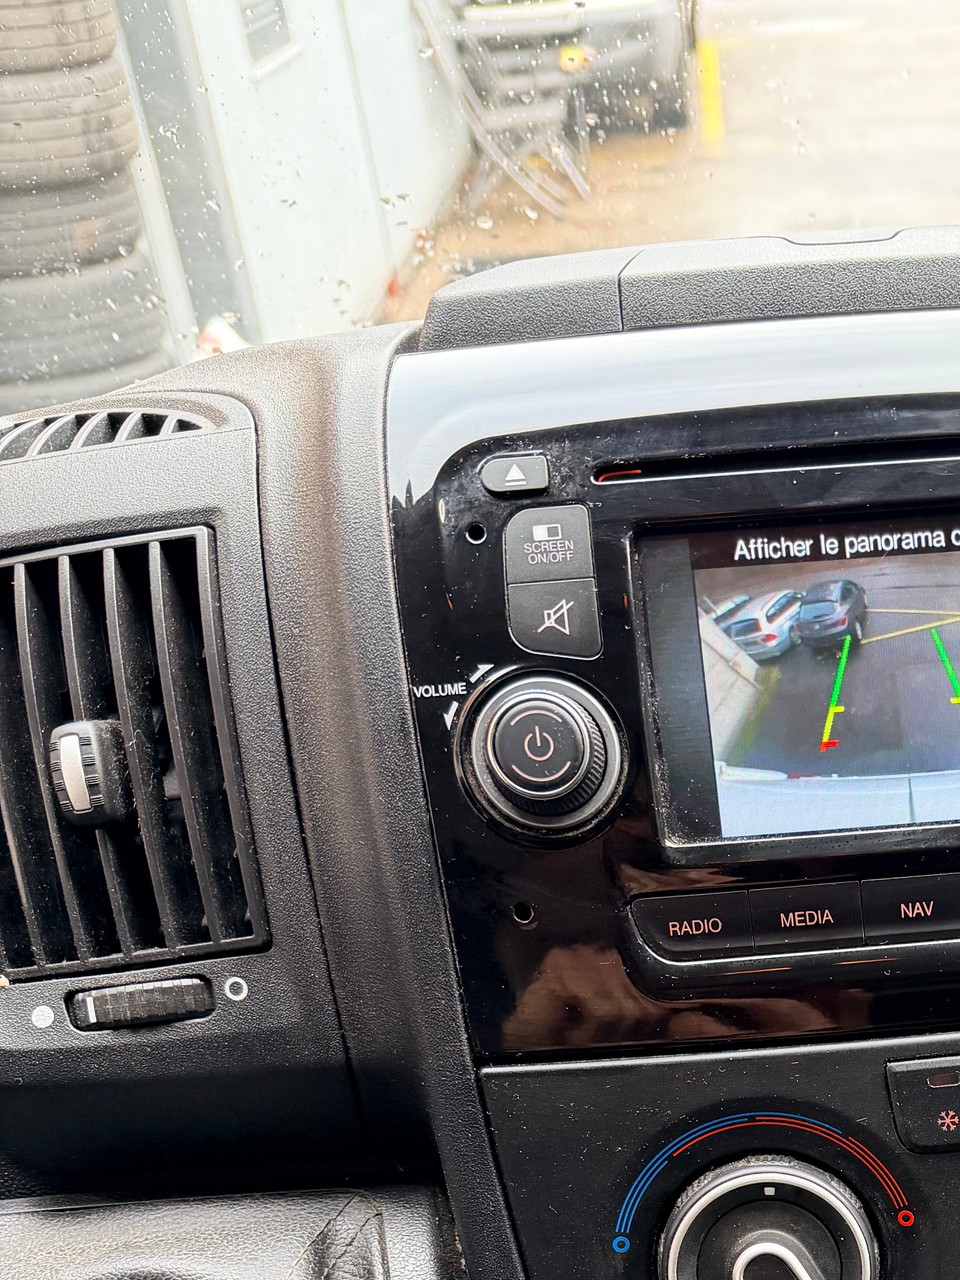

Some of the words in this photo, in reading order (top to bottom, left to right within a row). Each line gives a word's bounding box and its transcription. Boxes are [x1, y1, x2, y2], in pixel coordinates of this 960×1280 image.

[523, 540, 574, 553] SCREEN
[733, 536, 814, 561] Afficher
[820, 534, 839, 555] le
[845, 529, 946, 558] panorama
[527, 551, 574, 564] ON/OFF
[413, 682, 467, 698] VOLUME
[900, 901, 934, 918] NAV
[668, 918, 722, 936] RADIO
[780, 909, 834, 928] MEDIA
